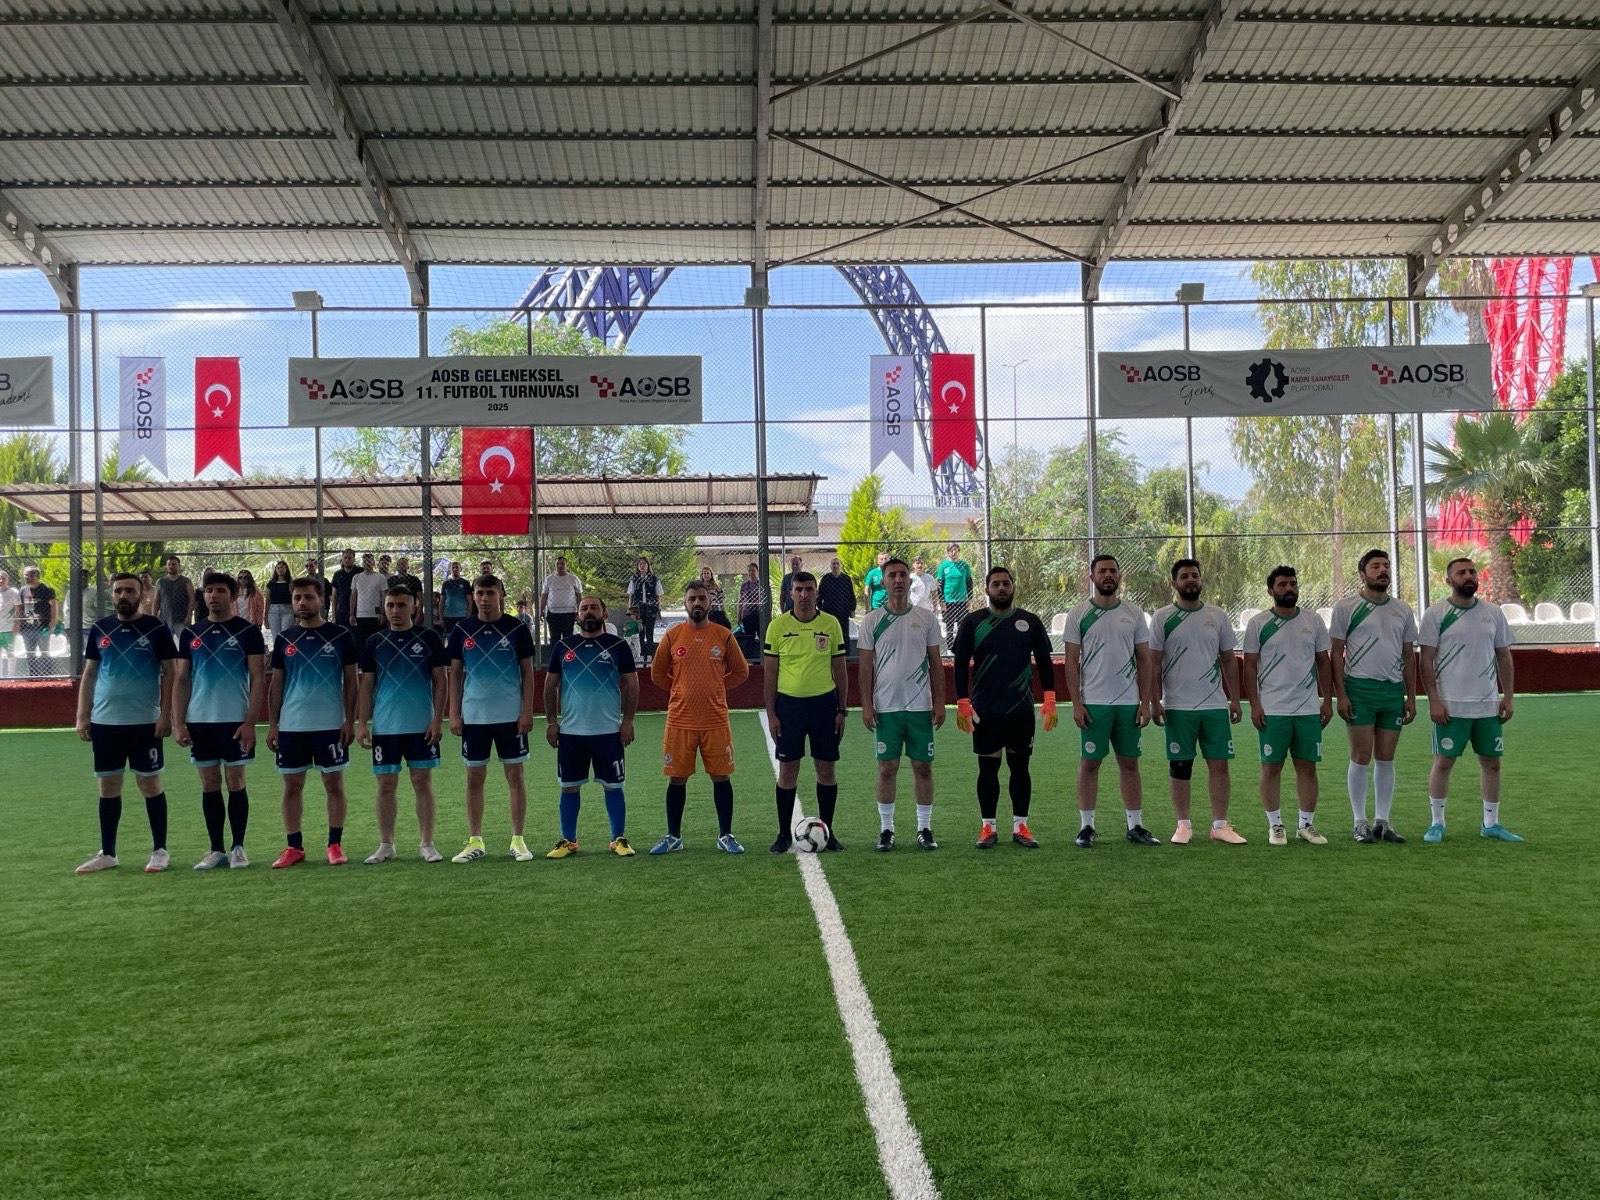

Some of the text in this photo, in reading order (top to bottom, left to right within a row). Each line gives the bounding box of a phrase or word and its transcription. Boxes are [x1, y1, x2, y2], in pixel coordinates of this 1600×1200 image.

[431, 369, 564, 382] AOSB GELENEKSEL
[1143, 365, 1201, 382] AOSB
[1398, 363, 1465, 383] AOSB
[416, 385, 579, 399] 11. FUTBOL TURNUVASI
[137, 388, 152, 439] AOSB
[487, 403, 509, 411] 2025
[886, 386, 901, 437] AOSB
[149, 748, 158, 764] 9
[374, 745, 383, 761] 8
